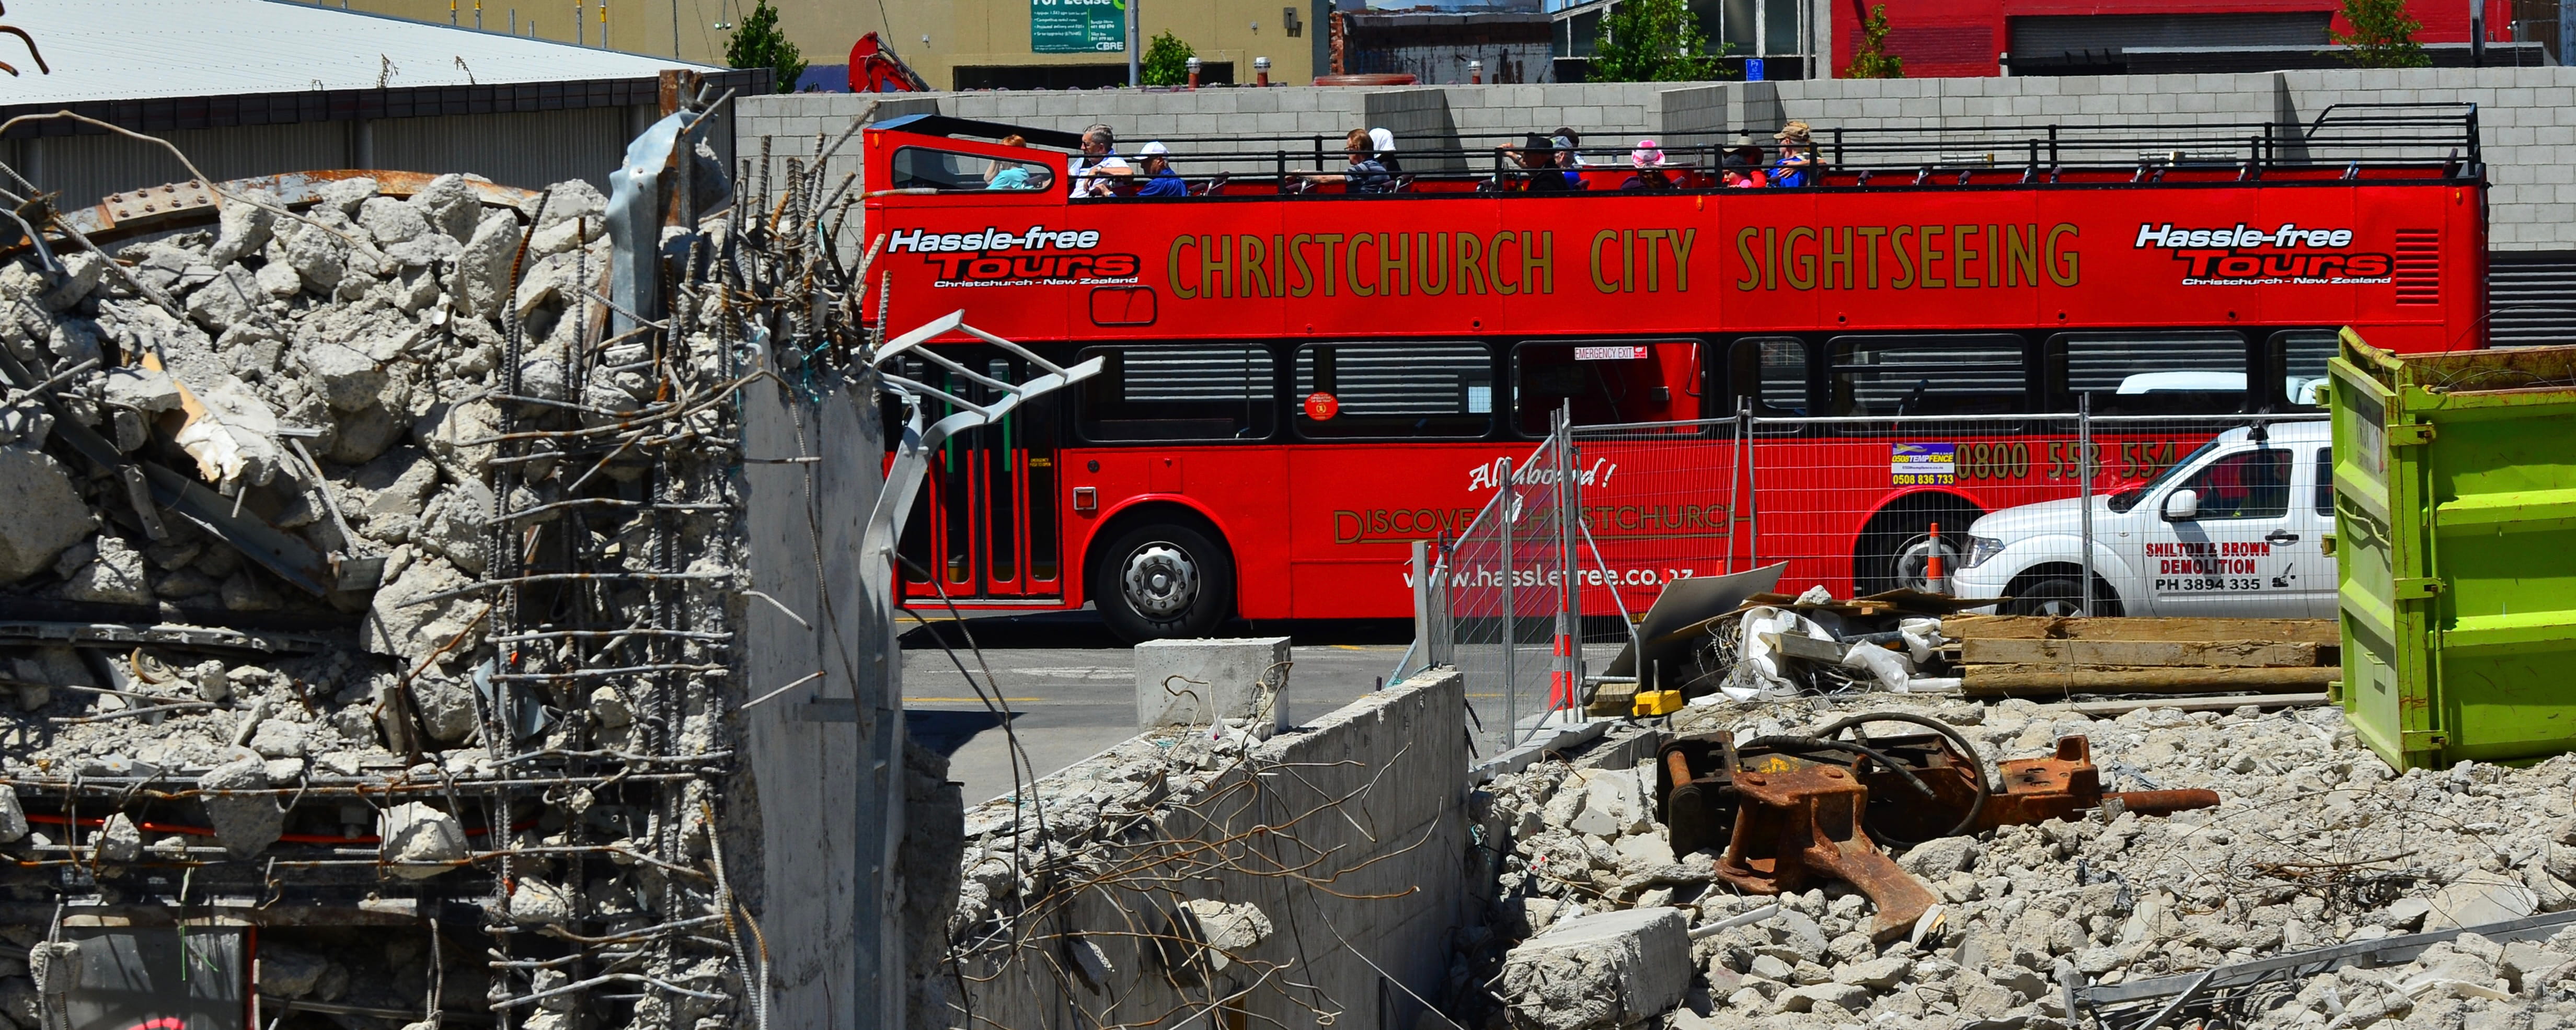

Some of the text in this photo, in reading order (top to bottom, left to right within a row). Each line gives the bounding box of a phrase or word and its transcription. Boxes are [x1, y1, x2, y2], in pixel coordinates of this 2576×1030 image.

[1096, 42, 1123, 50] CBRE
[888, 226, 1099, 253] Hassle-free
[2135, 224, 2352, 247] Hassle-free
[929, 253, 1138, 280] Tours
[1168, 223, 2079, 299] CHRISTCHURCH CITY SIGHTSEEING
[2176, 249, 2390, 277] Tours
[1575, 348, 1632, 359] EMERGENCY EXIT
[1956, 443, 2028, 478] 0800
[2122, 442, 2174, 478] 554
[1893, 474, 1954, 484] 0508 836 733
[1334, 509, 1494, 544] DISCOVER
[2146, 542, 2270, 557] SHILTON & BROWN
[2161, 559, 2256, 574] DEMOLITION
[2155, 578, 2260, 590] PH 3894 335
